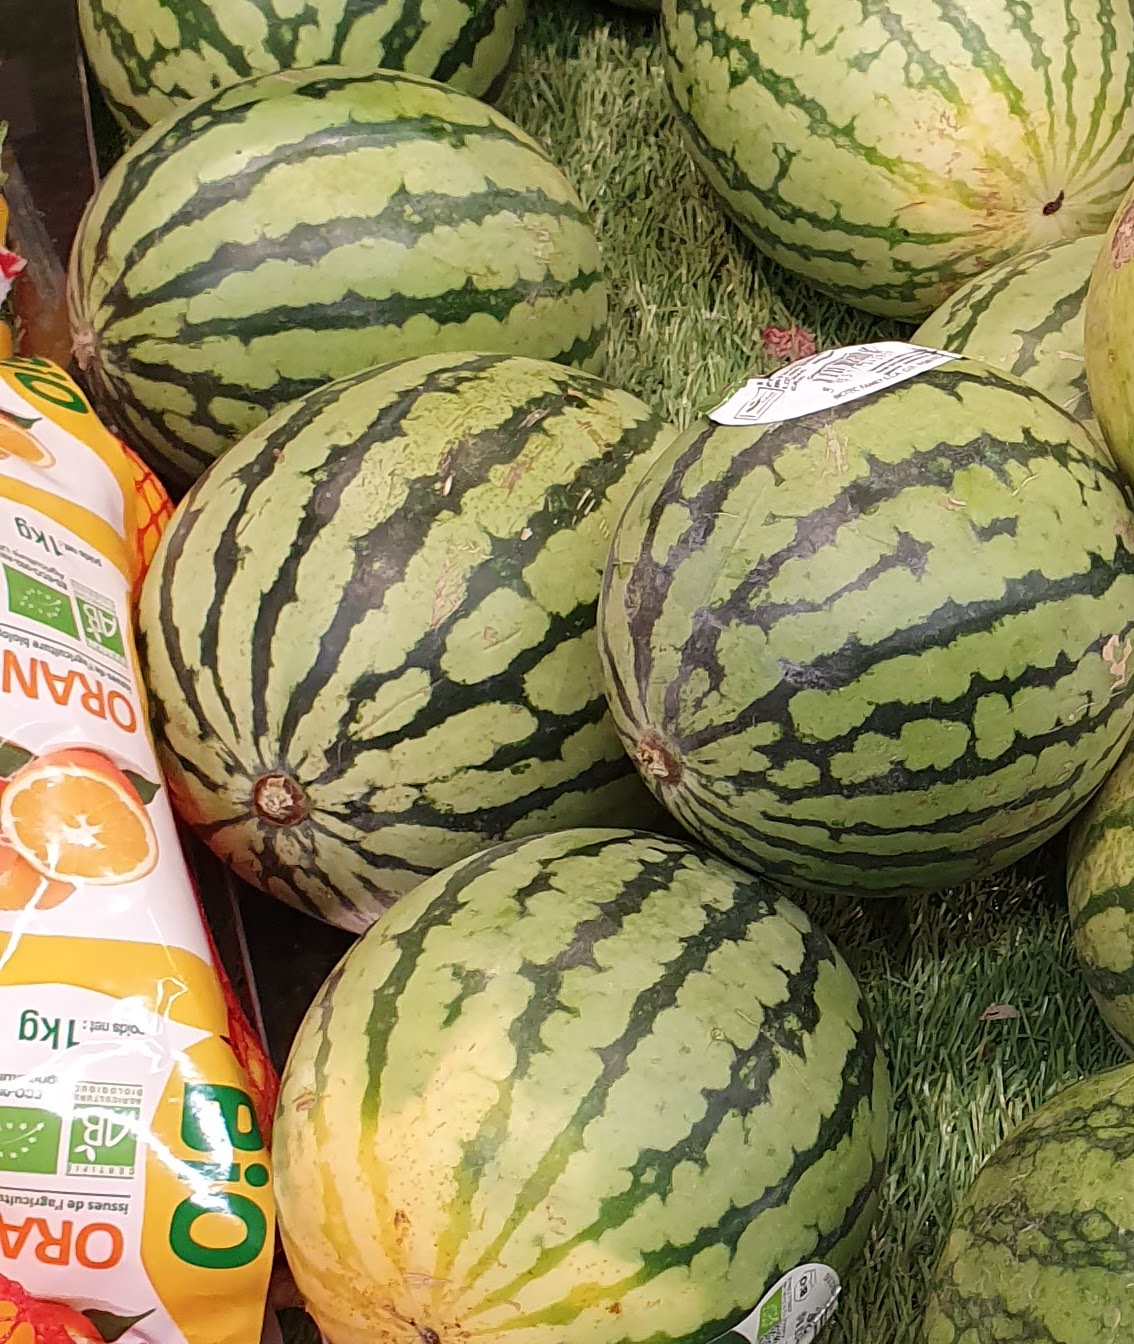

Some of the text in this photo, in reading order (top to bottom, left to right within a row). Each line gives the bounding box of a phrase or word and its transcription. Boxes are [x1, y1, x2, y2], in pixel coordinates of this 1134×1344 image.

[18, 1010, 79, 1049] 1kg
[66, 1199, 84, 1210] de
[88, 1201, 128, 1214] issues
